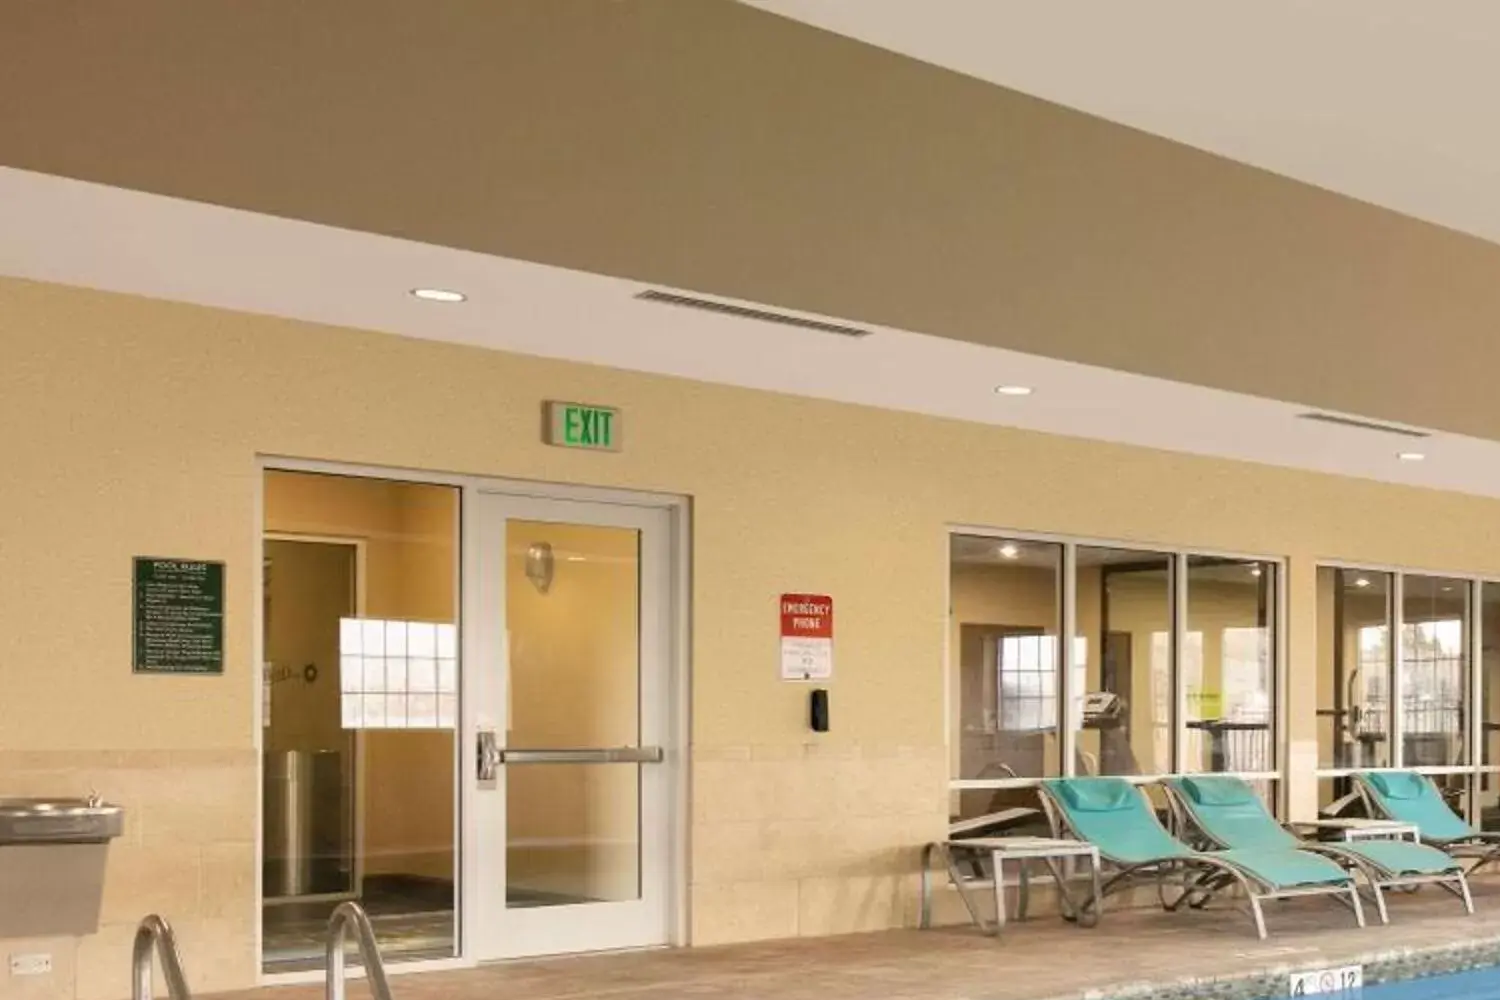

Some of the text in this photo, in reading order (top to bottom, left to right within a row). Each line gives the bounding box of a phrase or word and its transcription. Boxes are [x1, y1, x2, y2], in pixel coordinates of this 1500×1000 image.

[565, 407, 613, 447] EXIT
[783, 602, 829, 615] EMERGENCY
[793, 617, 821, 629] PHONE
[1294, 978, 1305, 997] 4
